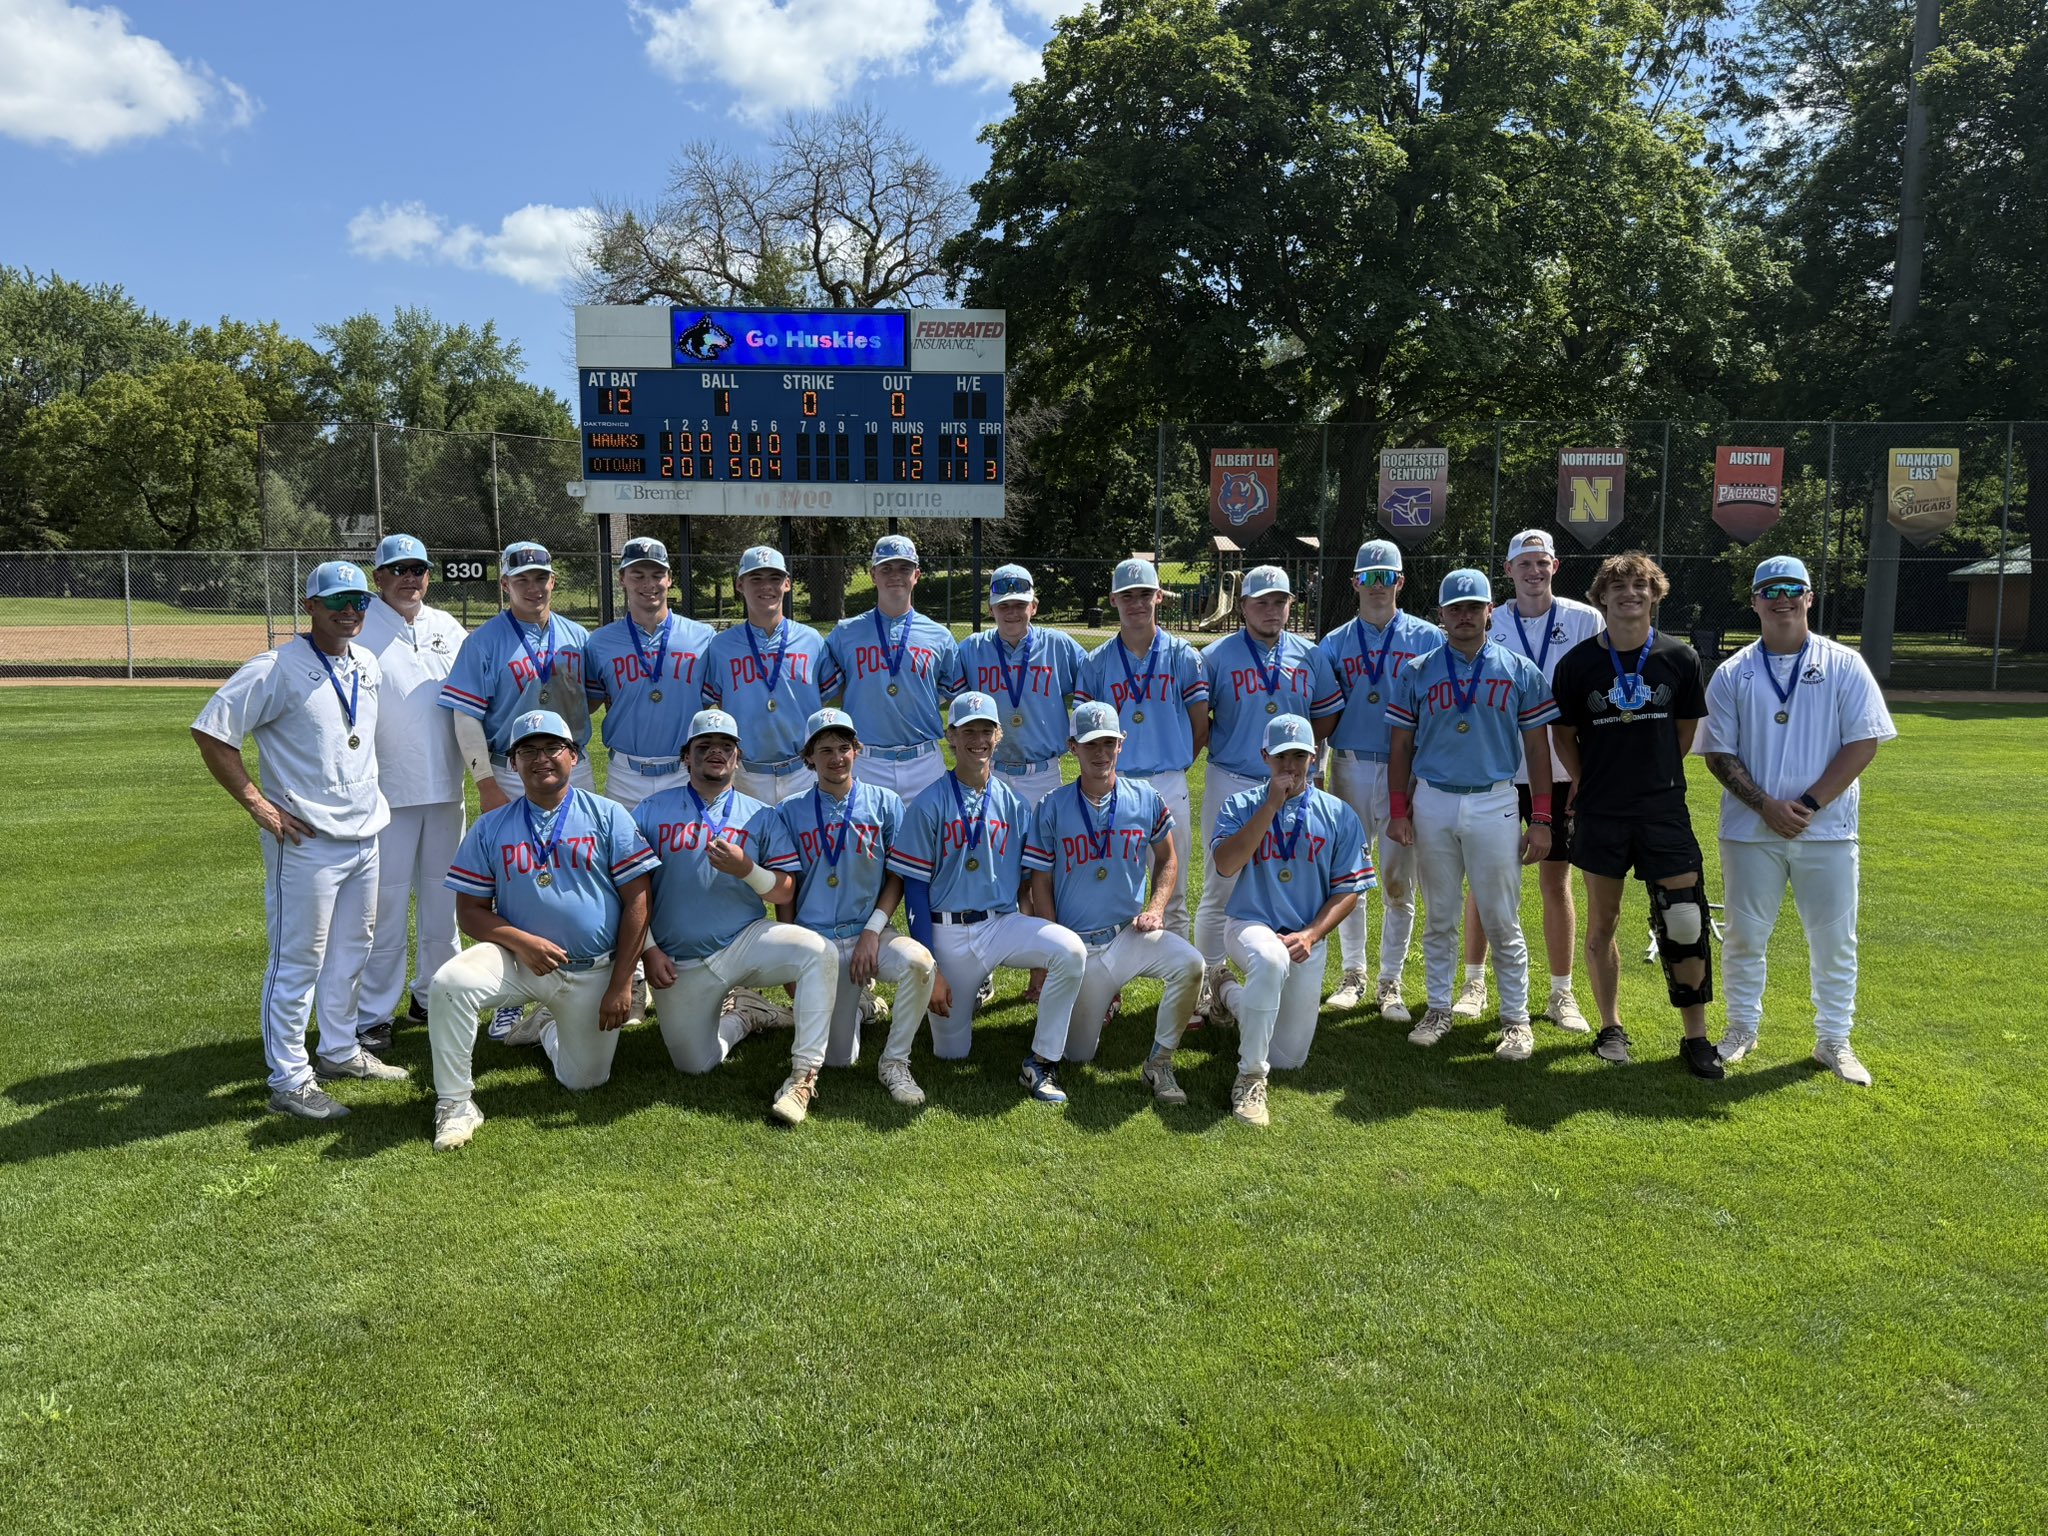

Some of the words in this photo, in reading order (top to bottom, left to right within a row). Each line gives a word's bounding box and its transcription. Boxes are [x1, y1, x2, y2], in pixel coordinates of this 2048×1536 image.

[746, 330, 778, 348] Go
[786, 330, 882, 349] Huskies
[916, 321, 1005, 338] FEDERATED
[912, 339, 975, 350] INSURANCE
[588, 372, 606, 387] AT
[611, 372, 638, 387] BAT
[702, 374, 739, 389] BALL
[783, 375, 835, 390] STRIKE
[882, 375, 912, 391] OUT
[956, 376, 981, 392] H/E
[608, 388, 631, 413] 12
[803, 391, 817, 416] 0
[891, 392, 905, 417] 0
[663, 419, 669, 430] 1
[682, 419, 689, 431] 2
[701, 420, 709, 431] 3
[731, 420, 739, 431] 4
[751, 420, 758, 432] 5
[770, 420, 778, 432] 6
[800, 421, 807, 433] 7
[819, 421, 826, 433] 8
[838, 421, 845, 433] 9
[865, 421, 878, 434] 10
[892, 421, 924, 434] RUNS
[941, 422, 967, 435] HITS
[979, 422, 1001, 435] ERR
[592, 434, 638, 448] HAWKS
[668, 434, 673, 450] 1
[680, 433, 692, 453] 0
[700, 433, 712, 453] 0
[729, 433, 741, 453] 0
[756, 435, 761, 452] 1
[769, 434, 780, 454] 0
[911, 435, 922, 455] 2
[956, 437, 968, 454] 4
[662, 457, 673, 476] 2
[681, 457, 693, 477] 0
[708, 459, 713, 475] 1
[730, 458, 741, 477] 5
[750, 458, 761, 477] 0
[769, 459, 781, 476] 4
[902, 459, 922, 480] 12
[947, 461, 968, 478] 11
[986, 460, 997, 480] 3
[1214, 454, 1253, 467] ALBERT
[1256, 454, 1275, 467] LEA
[1382, 453, 1446, 467] ROCHESTER
[1561, 453, 1624, 466] NORTHFIELD
[1729, 452, 1771, 466] AUSTIN
[1896, 453, 1953, 467] MANKATO
[1388, 467, 1438, 481] CENTURY
[1908, 467, 1938, 480] EAST
[633, 485, 692, 500] Bremer
[1569, 477, 1612, 522] N
[1718, 485, 1777, 504] PACKERS
[873, 491, 942, 515] prairie
[1899, 500, 1951, 516] COUGARS
[446, 562, 483, 578] 330
[561, 651, 582, 684] 77
[670, 652, 697, 684] 77
[786, 653, 808, 684] 77
[909, 646, 932, 680] 77
[1030, 665, 1052, 697] 77
[1158, 673, 1175, 702] 7
[1286, 667, 1308, 698] 77
[1486, 679, 1513, 712] 77
[722, 827, 748, 850] 77
[854, 823, 879, 859] 77
[990, 819, 1010, 856] 77
[1119, 829, 1143, 863] 77
[1305, 832, 1326, 863] 77
[567, 836, 596, 872] 77
